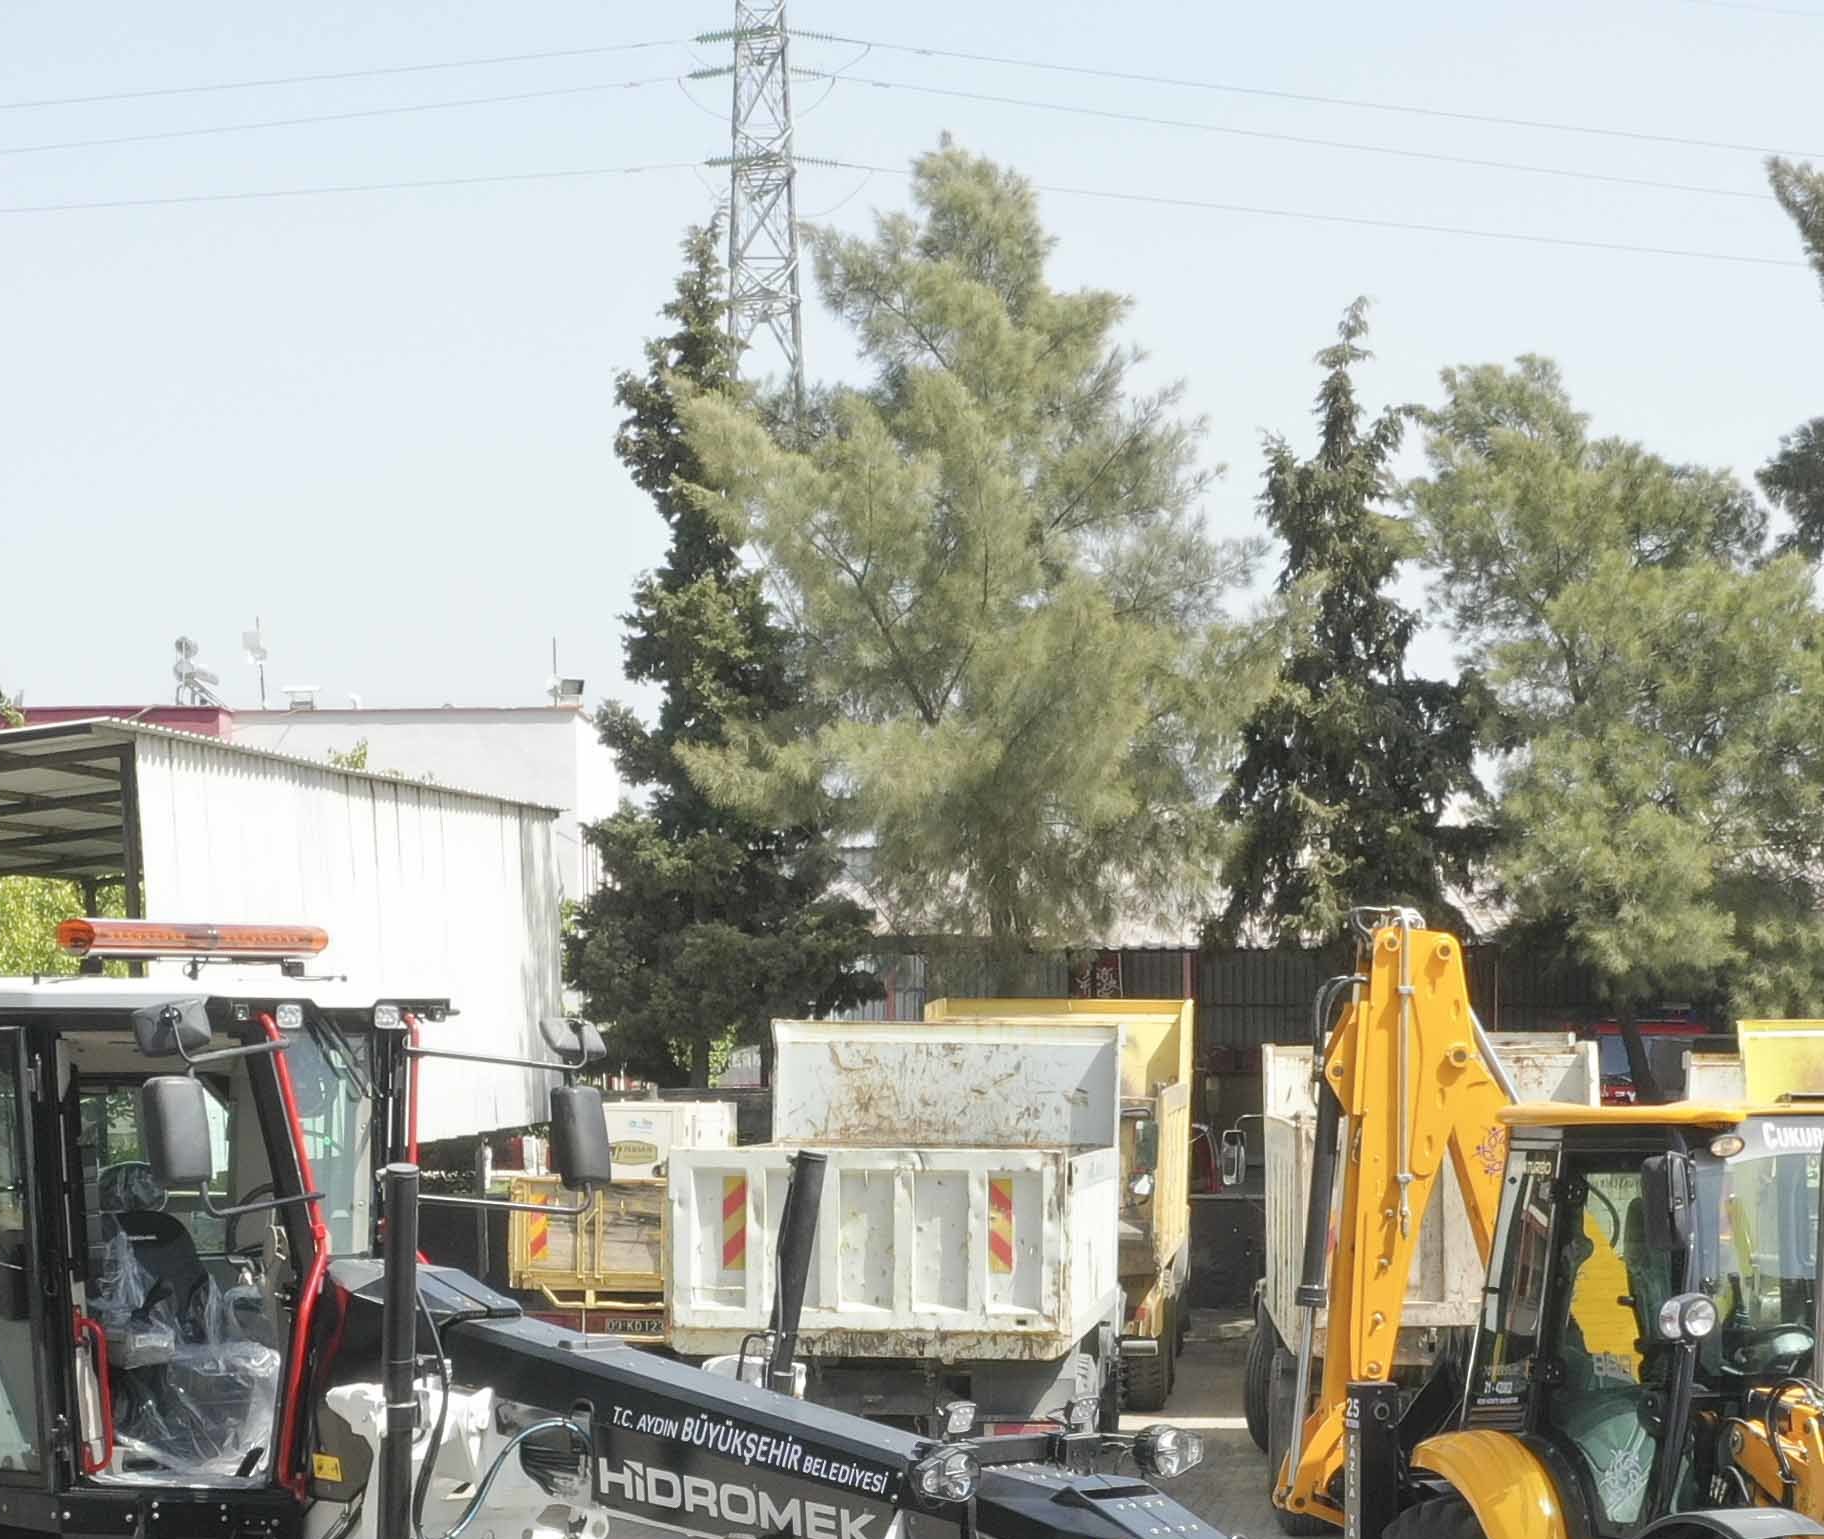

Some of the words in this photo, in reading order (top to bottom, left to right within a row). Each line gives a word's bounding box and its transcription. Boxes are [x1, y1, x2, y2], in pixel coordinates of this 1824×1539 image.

[1346, 1398, 1360, 1418] 25
[612, 1406, 634, 1429] T.C.
[636, 1414, 679, 1439] AYDIN
[681, 1413, 803, 1471] BÜYÜKŞEHİR
[802, 1455, 889, 1494] BELEDİYESİ
